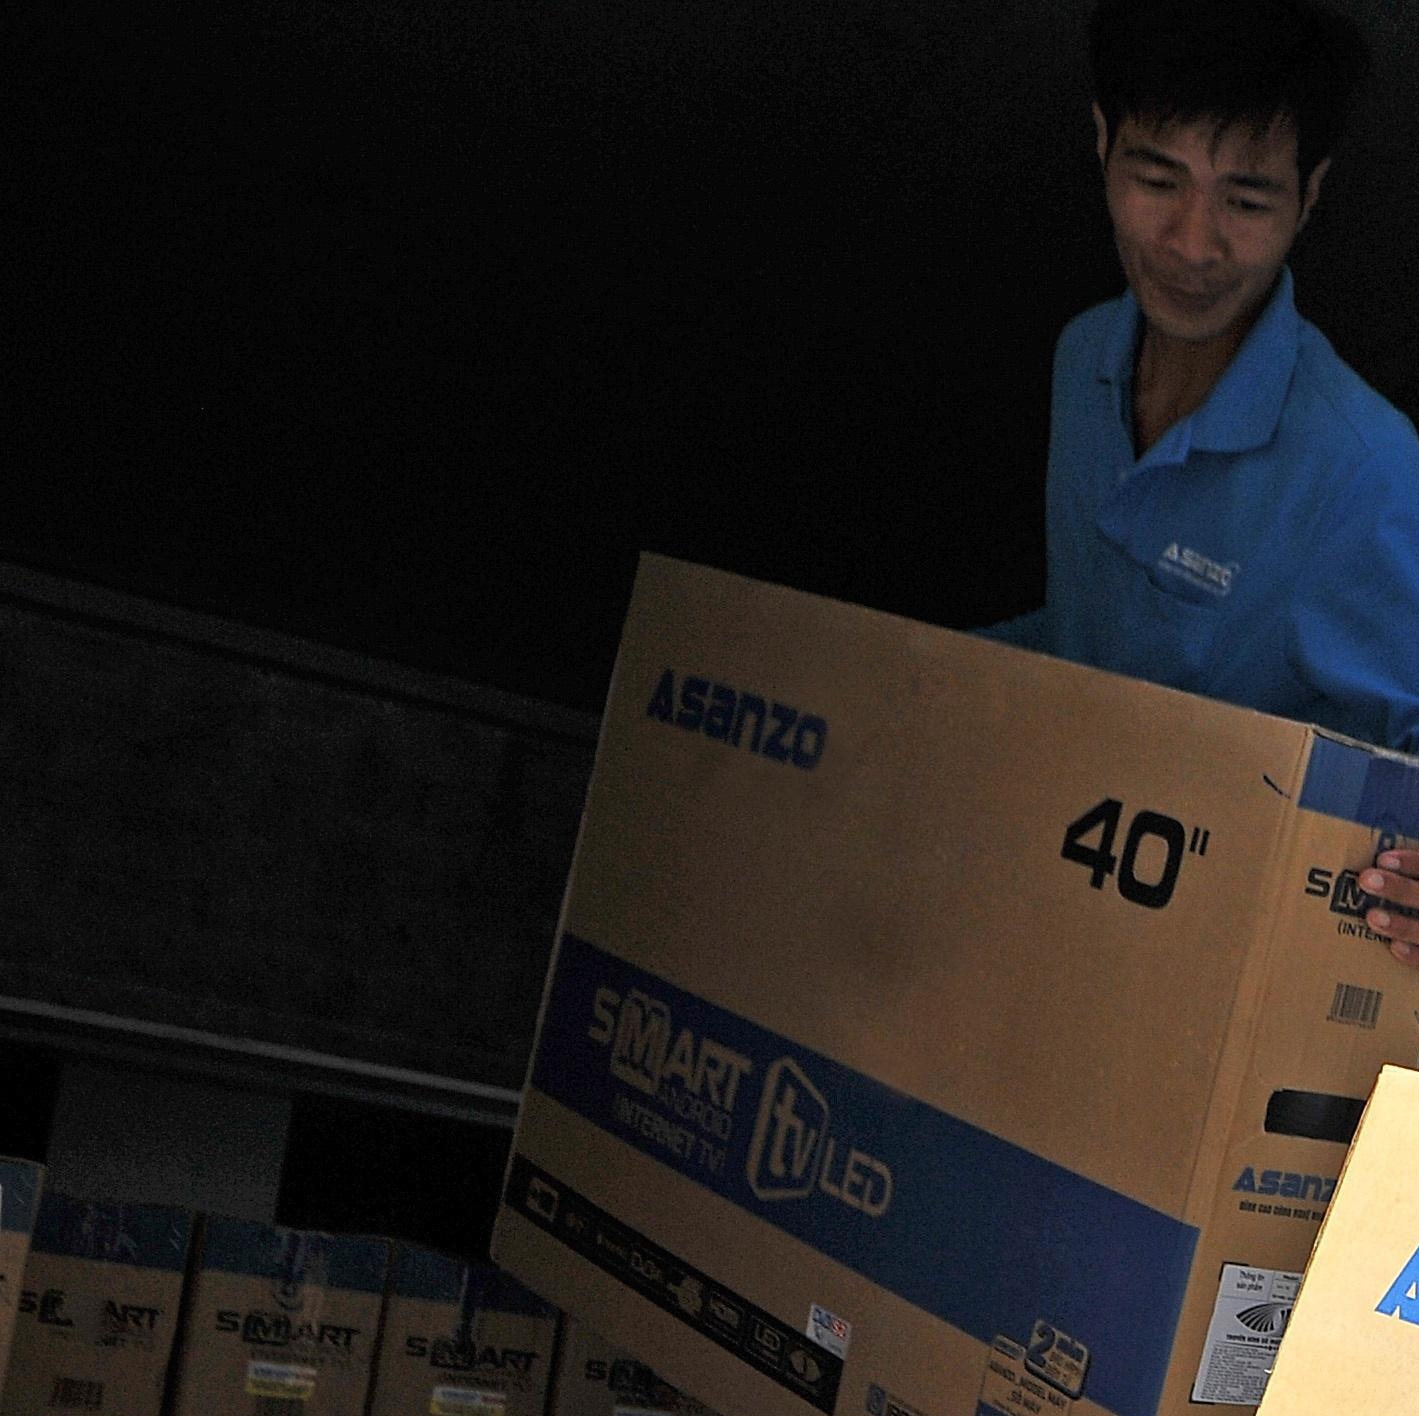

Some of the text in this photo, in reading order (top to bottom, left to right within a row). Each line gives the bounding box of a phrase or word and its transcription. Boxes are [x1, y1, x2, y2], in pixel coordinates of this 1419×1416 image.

[647, 668, 827, 770] Asanzo
[1061, 798, 1209, 909] 40"
[588, 984, 753, 1115] SMART
[820, 1136, 893, 1217] LED
[1232, 1166, 1337, 1202] Asanz
